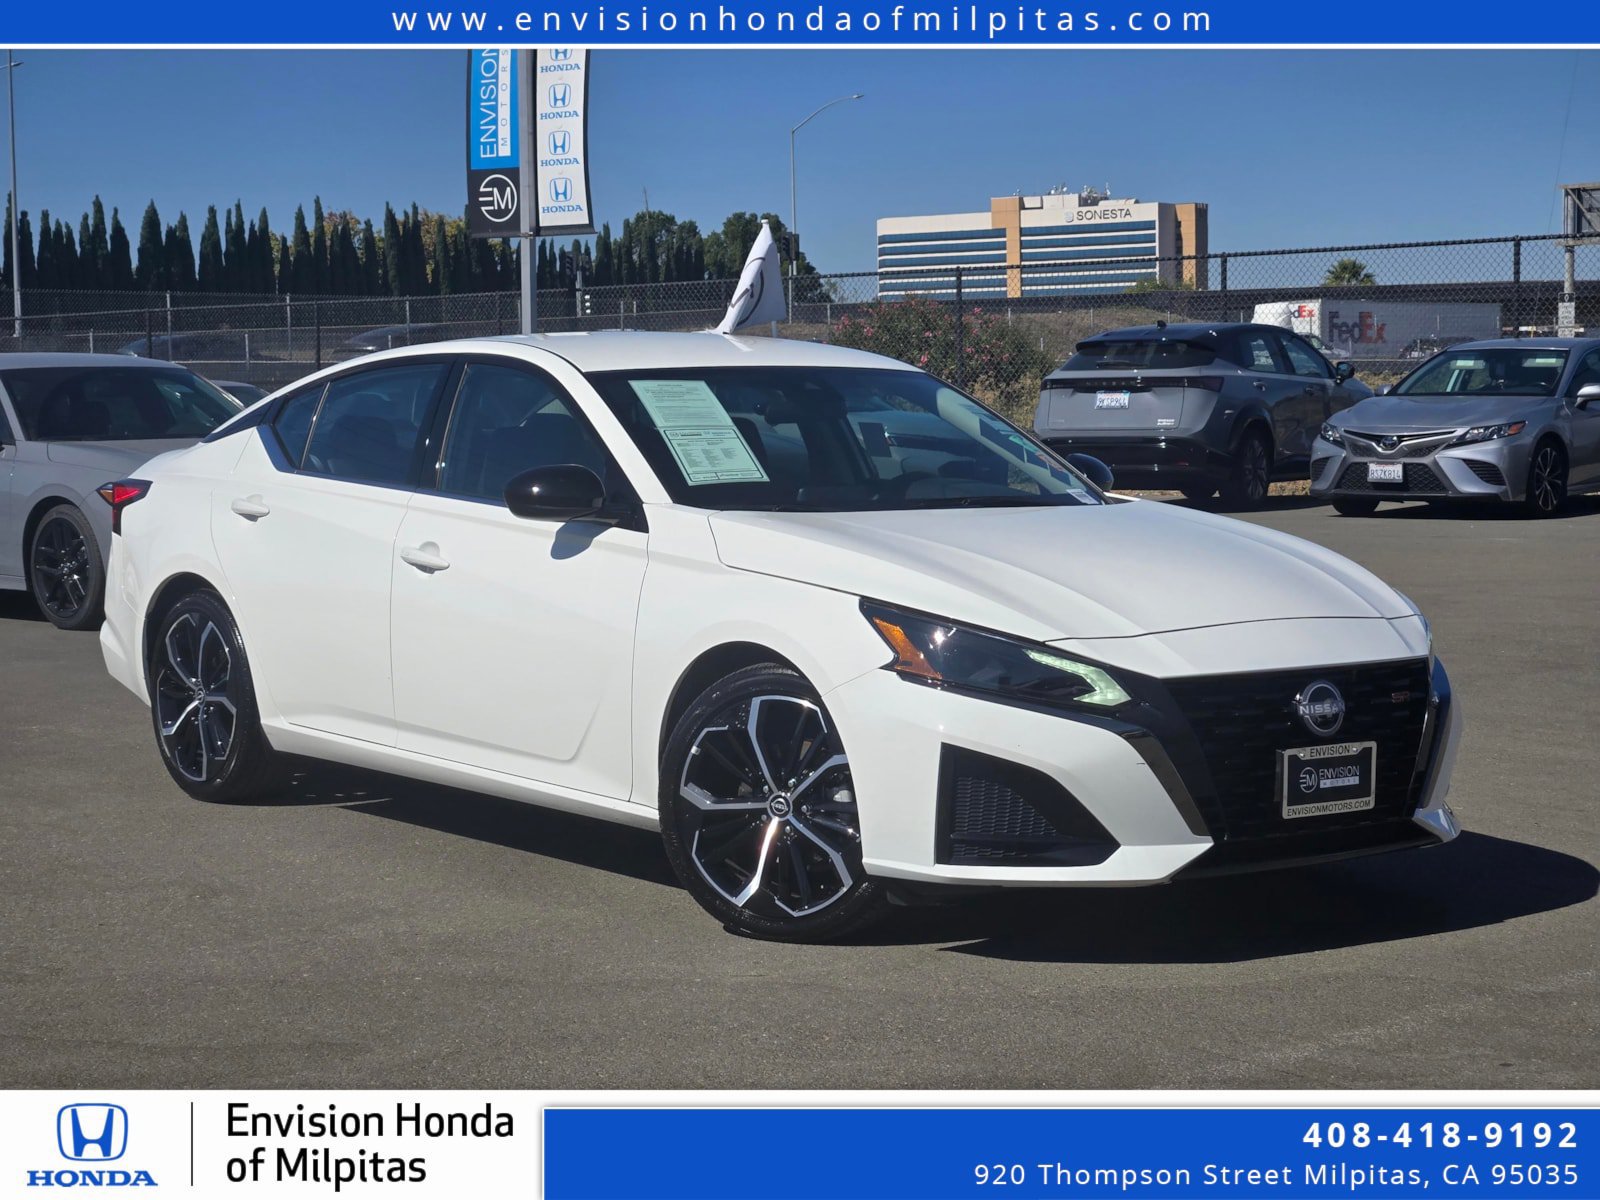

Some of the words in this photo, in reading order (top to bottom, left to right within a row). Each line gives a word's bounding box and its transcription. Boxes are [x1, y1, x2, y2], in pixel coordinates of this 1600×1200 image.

[540, 63, 581, 73] HONDA
[501, 49, 509, 146] MOTORS
[540, 110, 580, 120] HONDA
[540, 157, 580, 167] HONDA
[542, 204, 583, 214] HONDA
[1076, 208, 1132, 221] SONESTA
[1328, 311, 1386, 344] FedEx
[1299, 702, 1345, 715] NISSAN
[1309, 745, 1351, 758] ENVISION
[1319, 766, 1360, 780] ENVISION
[1287, 799, 1371, 817] ENVISIONMOTORS.COM
